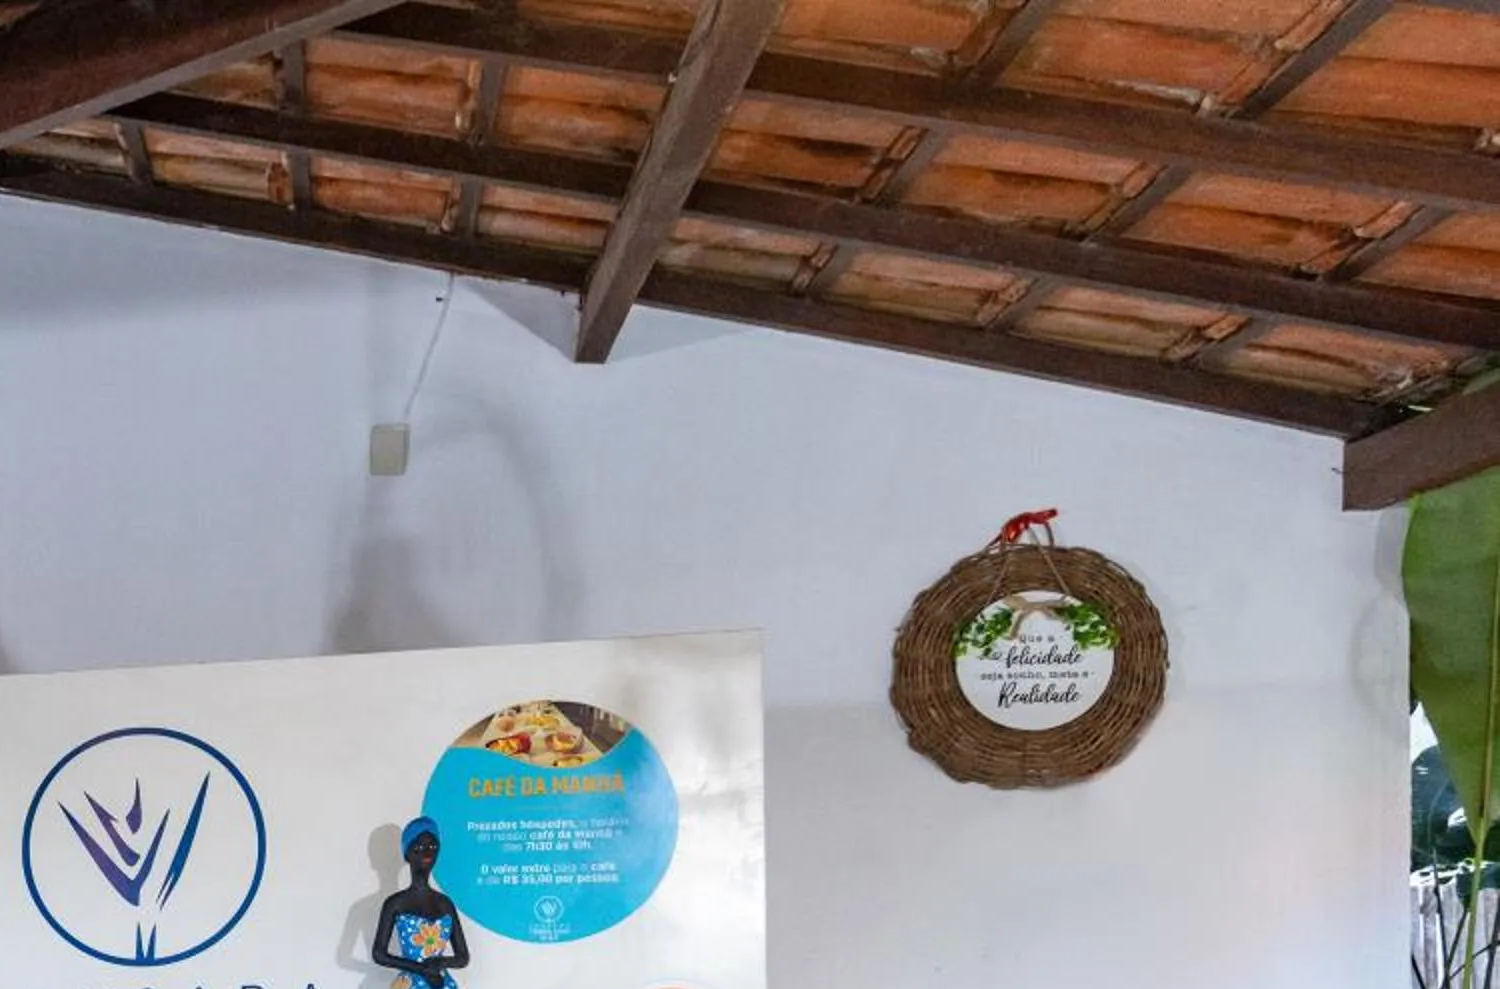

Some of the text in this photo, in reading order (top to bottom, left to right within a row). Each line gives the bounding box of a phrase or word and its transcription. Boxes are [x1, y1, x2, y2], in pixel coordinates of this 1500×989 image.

[1006, 643, 1082, 668] felicidade
[998, 681, 1082, 708] Realidade
[468, 774, 515, 799] CAFÉ
[521, 776, 546, 797] DA
